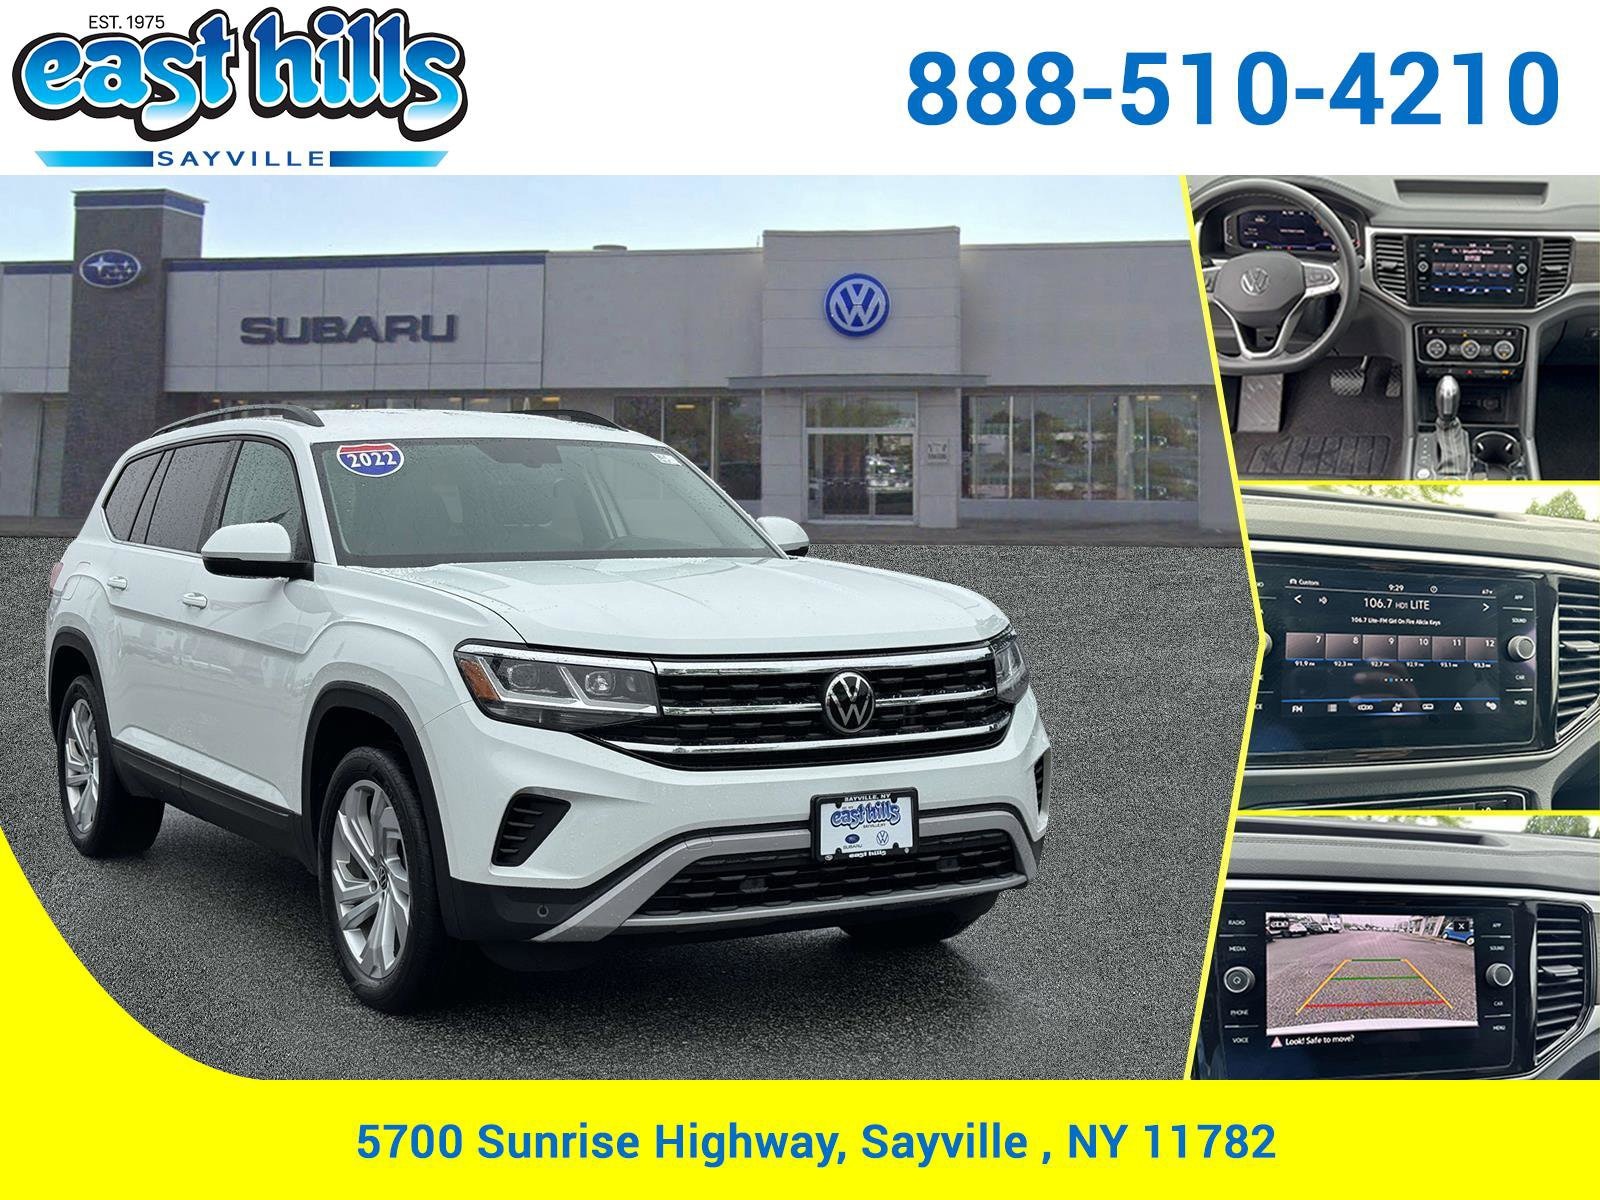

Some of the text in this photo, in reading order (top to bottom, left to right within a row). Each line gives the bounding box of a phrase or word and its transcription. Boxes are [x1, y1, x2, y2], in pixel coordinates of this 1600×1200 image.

[240, 314, 459, 345] SUBARU
[347, 450, 397, 468] 2022
[1388, 583, 1405, 592] 9:29
[1363, 597, 1393, 609] 106.7
[1410, 599, 1430, 611] LITE
[1315, 635, 1322, 644] 7
[1352, 636, 1360, 645] 8
[1388, 637, 1395, 646] 9
[1419, 638, 1430, 646] 10
[1453, 639, 1462, 647] 11
[1486, 640, 1495, 648] 12
[1291, 704, 1303, 713] FM
[830, 800, 901, 830] east hills
[1306, 1036, 1322, 1045] Safe
[1323, 1036, 1331, 1044] to
[1332, 1033, 1355, 1043] move?
